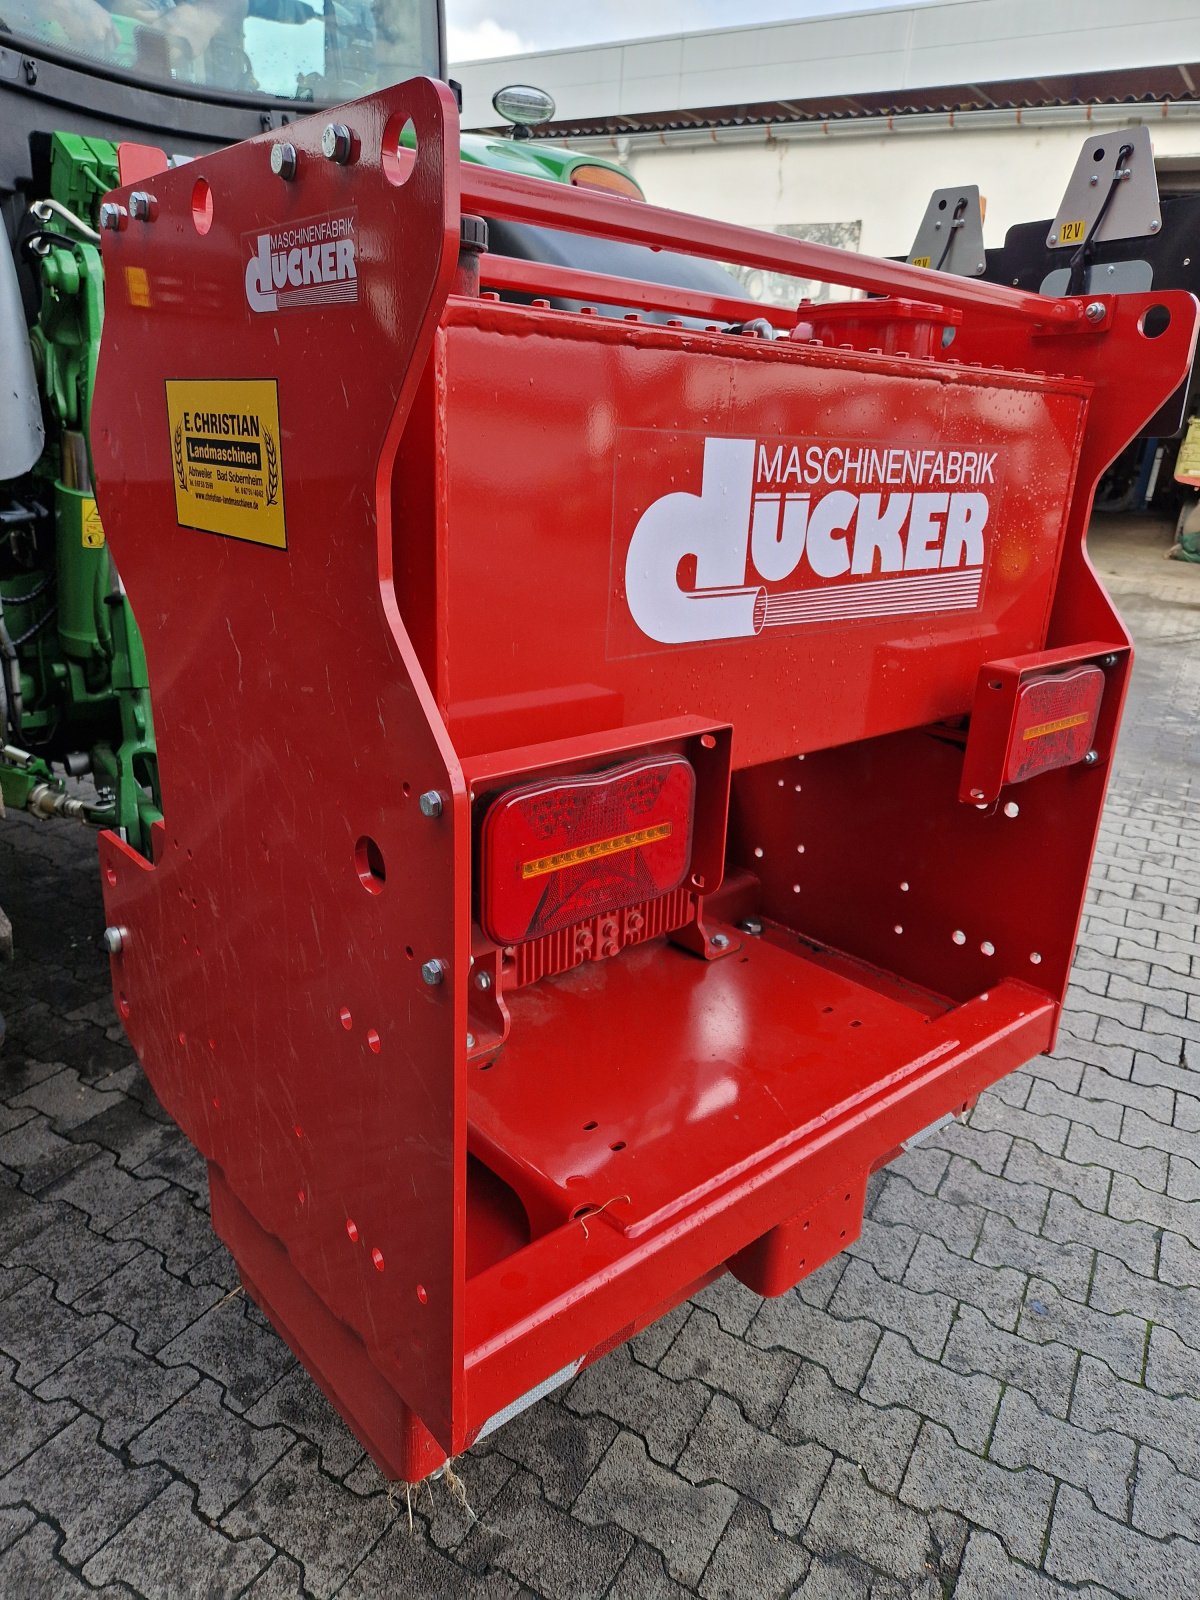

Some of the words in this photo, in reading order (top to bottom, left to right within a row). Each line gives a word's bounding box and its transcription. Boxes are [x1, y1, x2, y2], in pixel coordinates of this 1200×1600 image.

[271, 216, 355, 250] MASCHINENFABRIK
[1062, 224, 1074, 240] 12
[1074, 223, 1081, 238] V
[189, 441, 258, 465] Landmaschinen
[756, 445, 998, 484] MASCHINENFABRIK
[216, 470, 228, 481] Bad
[228, 471, 263, 486] Sobernheim
